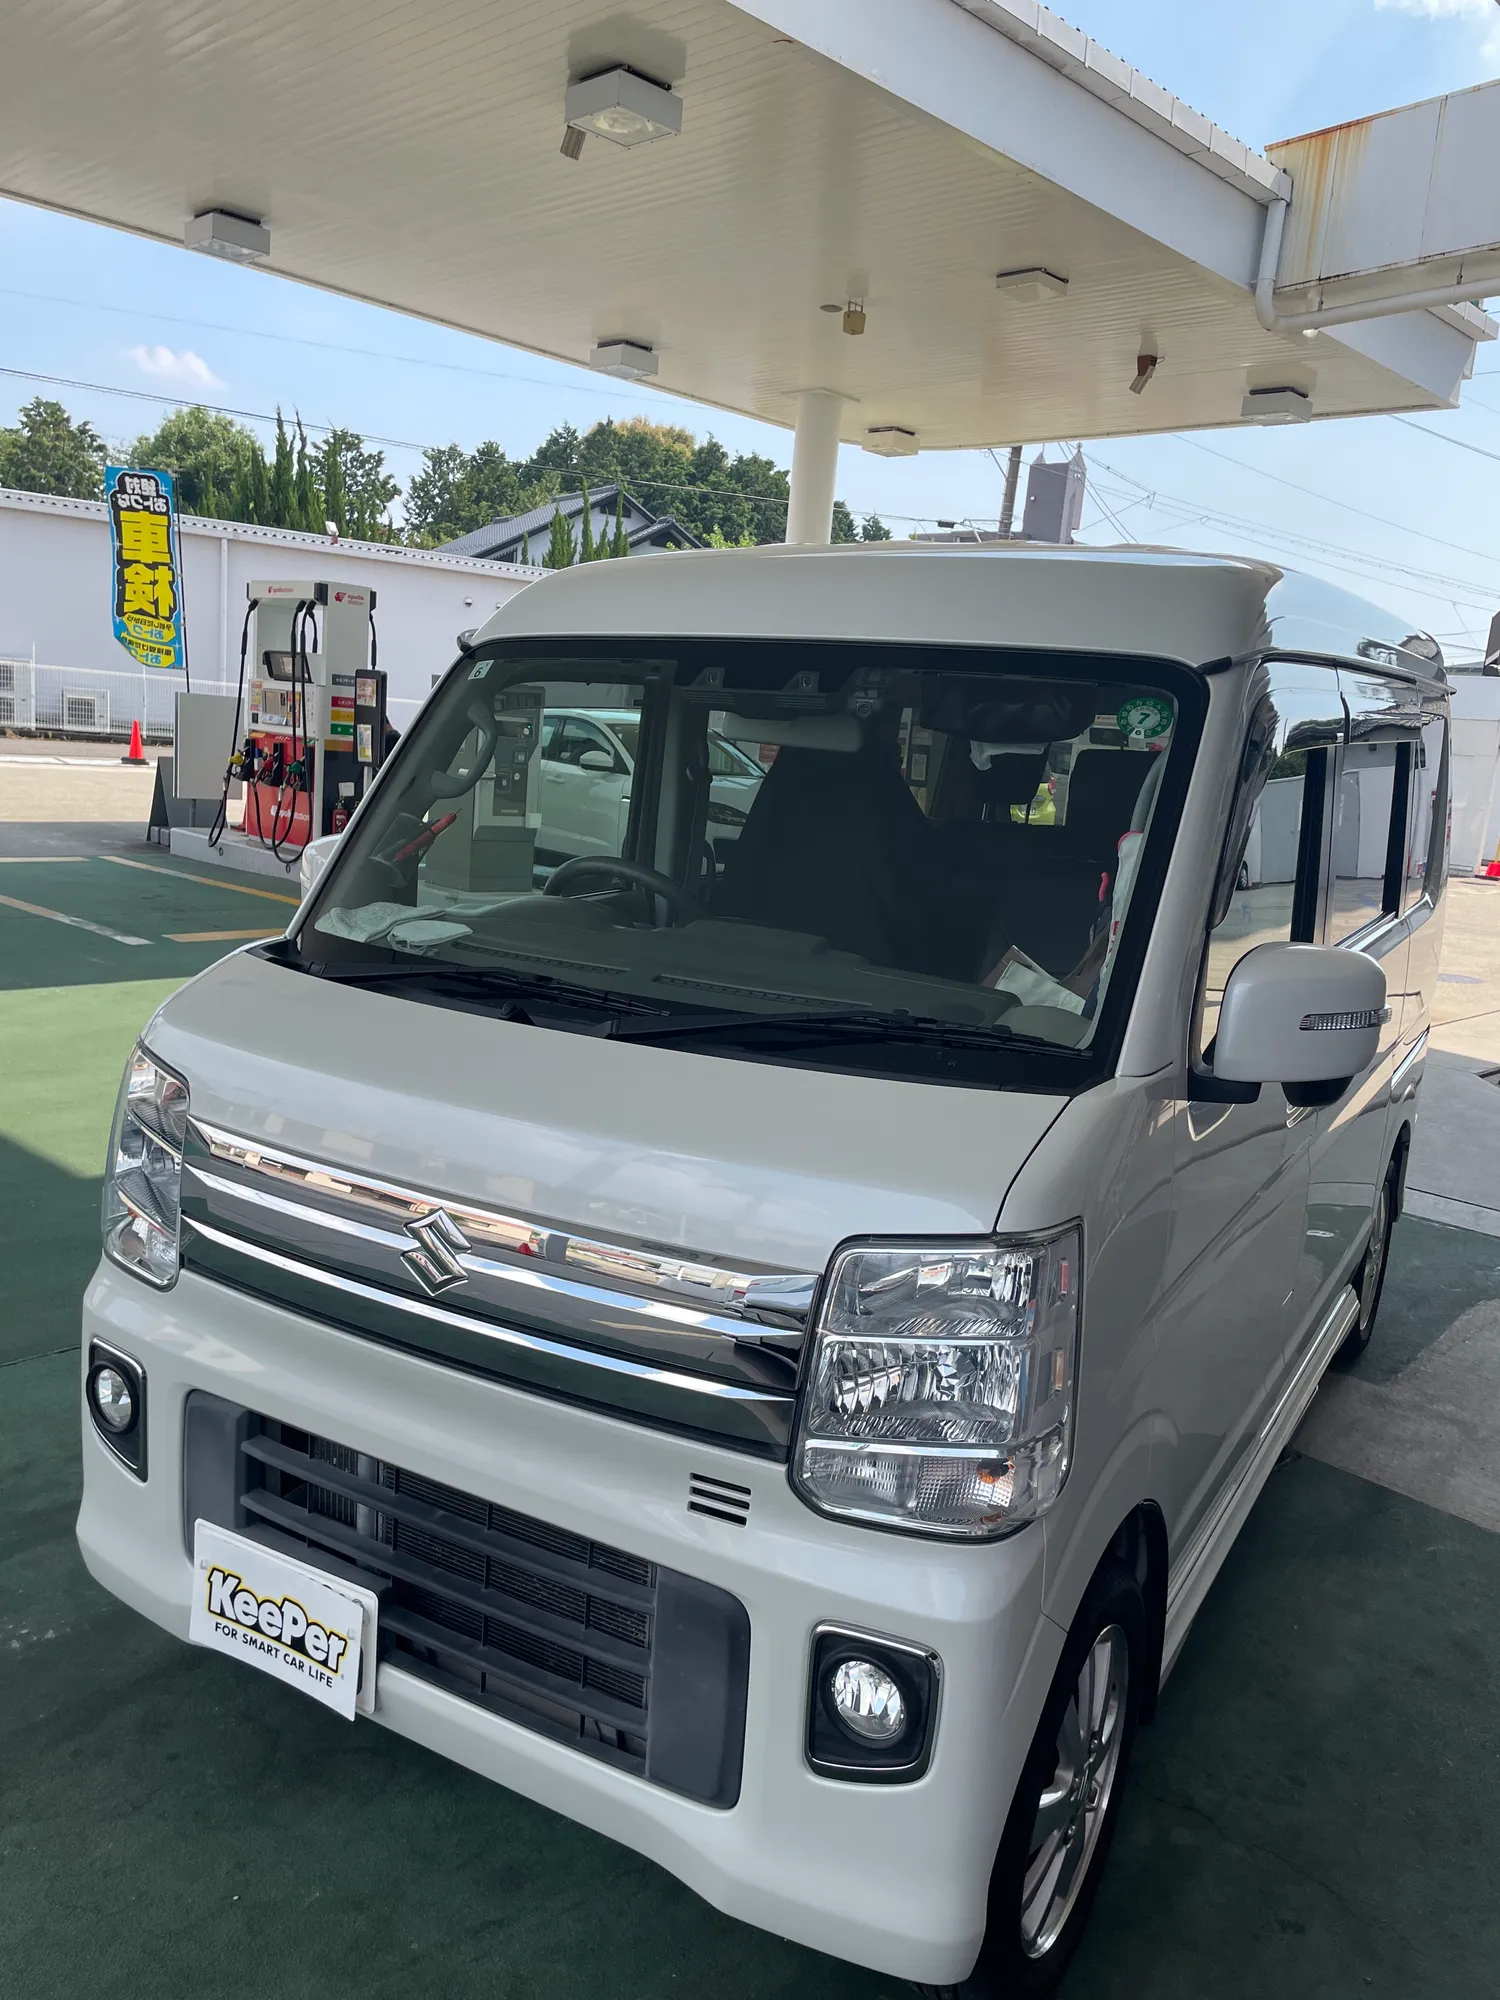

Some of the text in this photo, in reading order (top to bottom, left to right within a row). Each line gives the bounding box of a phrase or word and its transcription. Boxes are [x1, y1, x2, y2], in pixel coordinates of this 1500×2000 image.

[474, 667, 483, 677] 6
[1137, 711, 1151, 725] 7
[208, 1567, 347, 1674] KeePer
[214, 1621, 333, 1688] FOR SMART CAR LIFE
